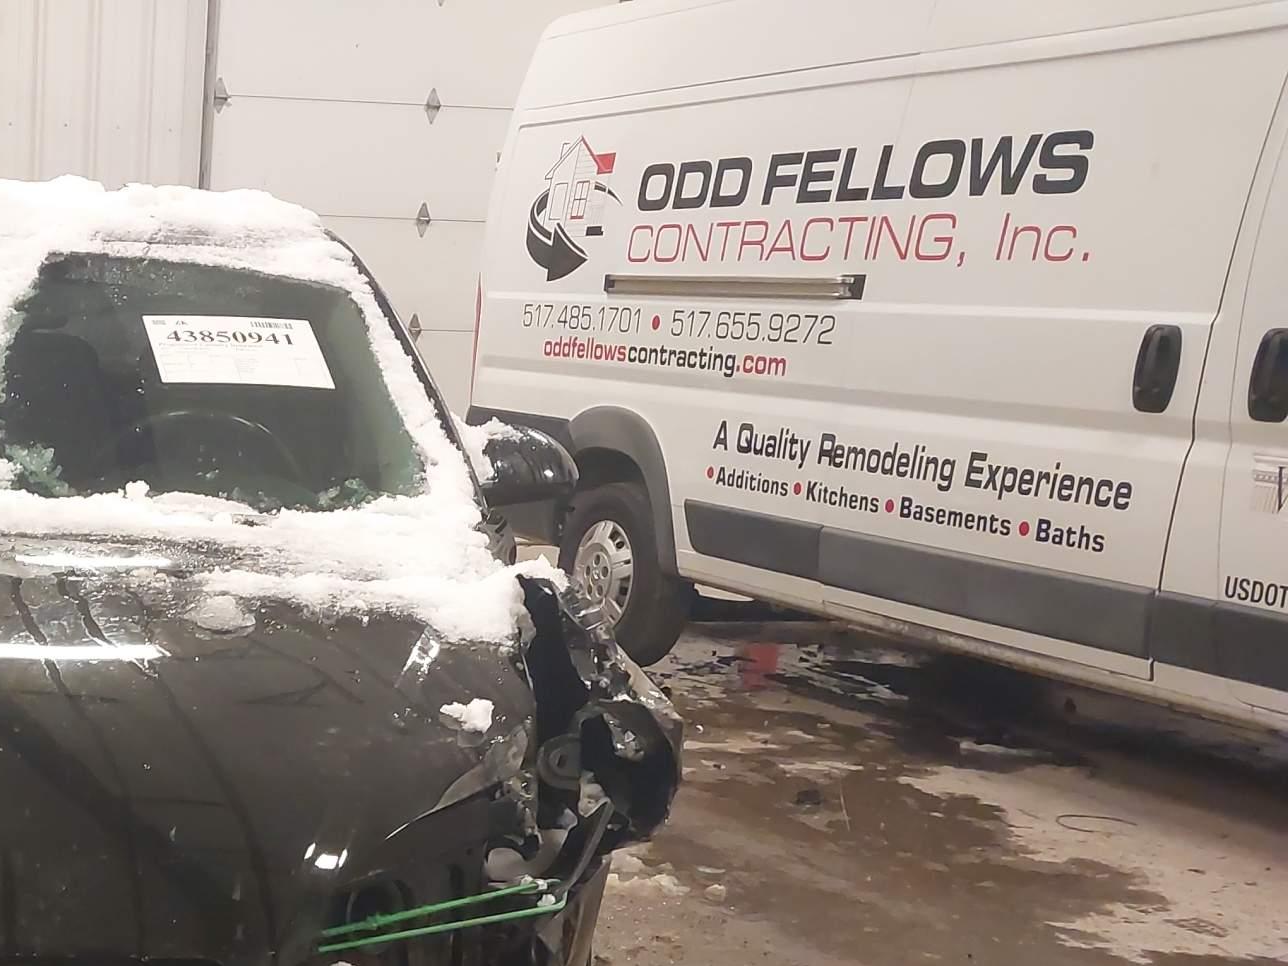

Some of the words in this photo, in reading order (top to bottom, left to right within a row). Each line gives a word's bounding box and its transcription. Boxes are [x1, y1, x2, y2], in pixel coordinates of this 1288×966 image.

[637, 157, 753, 212] ODD
[761, 130, 1094, 206] FELLOWS
[626, 213, 966, 267] CONTRACTING,
[995, 213, 1090, 262] Inc.
[166, 329, 294, 346] 43850941
[522, 303, 642, 334] 517.485.1701
[670, 309, 837, 345] 517.655.9272
[543, 336, 787, 378] oddfellowscontracting.com
[712, 420, 728, 451] A
[736, 422, 811, 470] Quality
[817, 432, 956, 492] Remodeling
[964, 451, 1133, 511] Experience
[715, 466, 789, 497] Additions
[805, 480, 880, 513] Kitchens
[899, 496, 1012, 536] Basements
[1034, 518, 1105, 553] Baths
